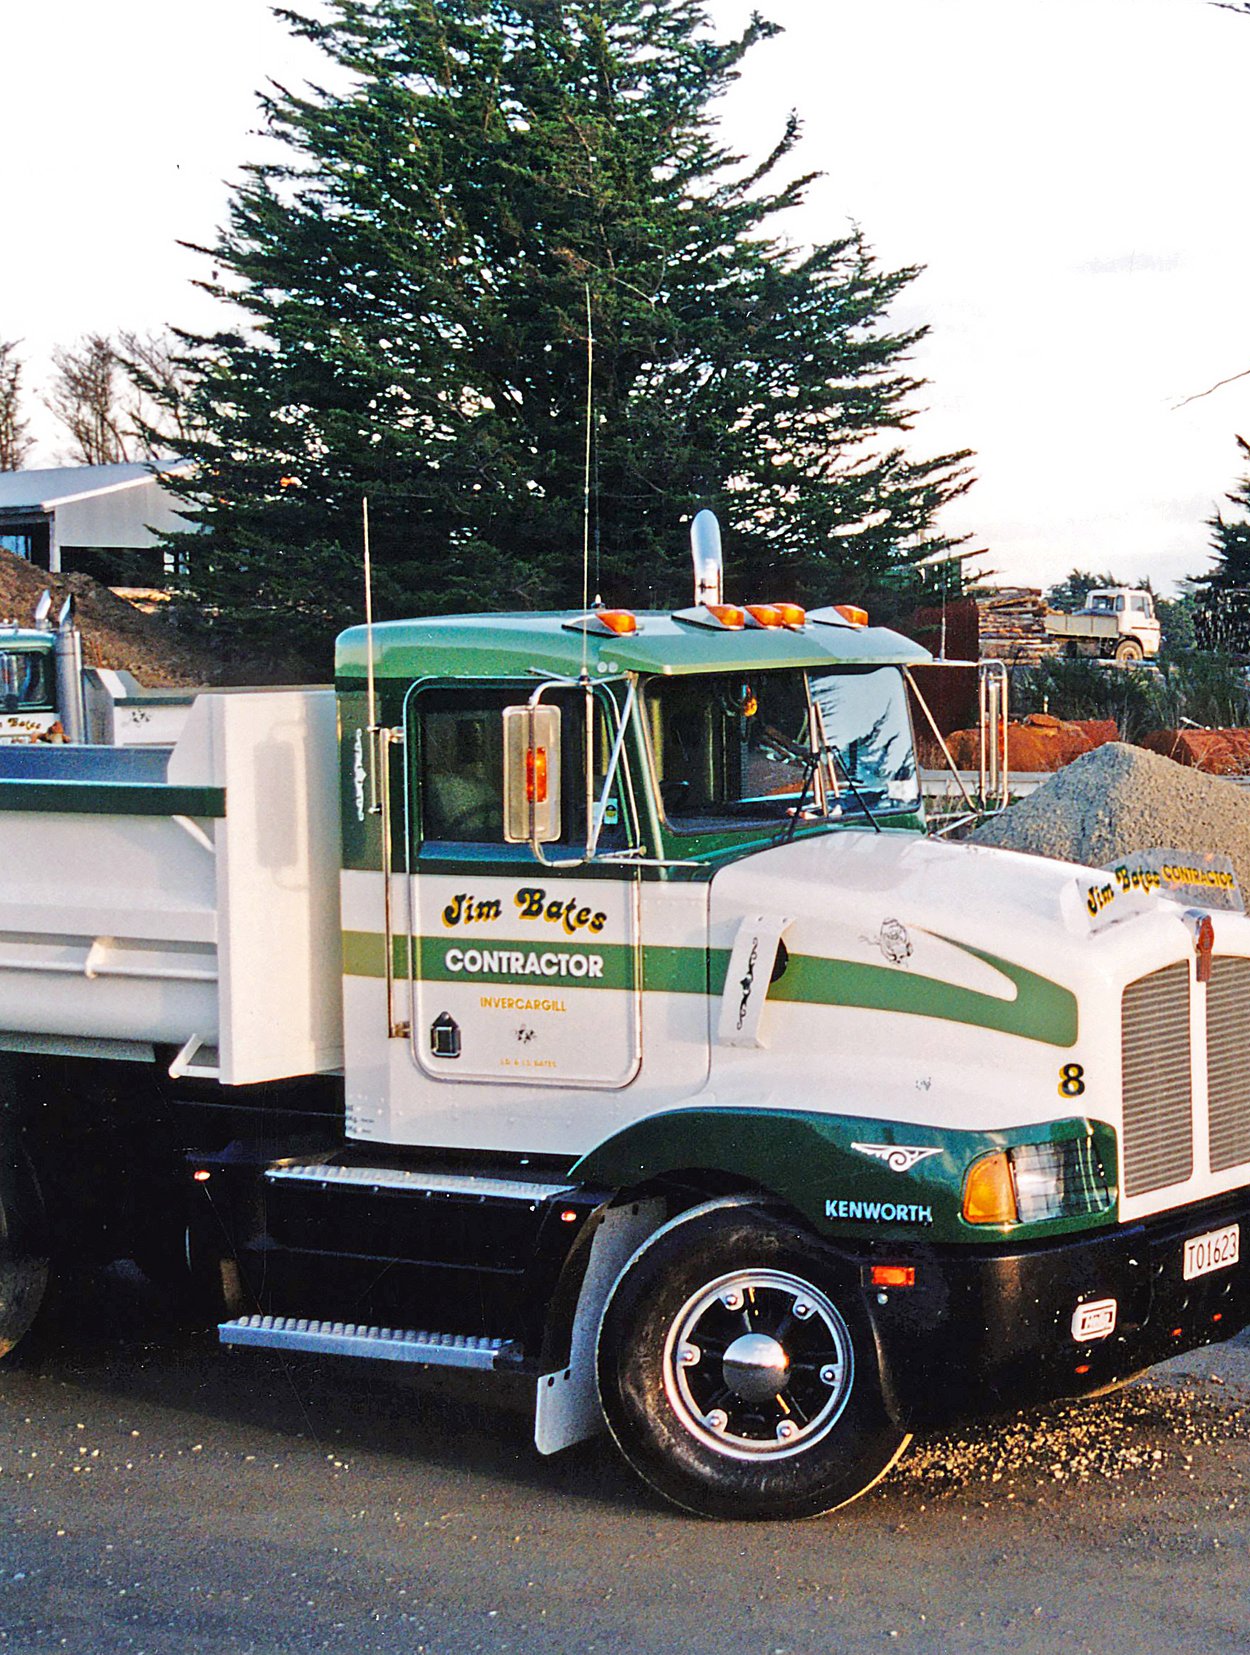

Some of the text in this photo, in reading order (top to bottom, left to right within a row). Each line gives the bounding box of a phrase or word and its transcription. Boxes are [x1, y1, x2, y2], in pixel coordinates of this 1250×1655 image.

[1087, 863, 1236, 918] Jim Bates CONTRACTOR
[441, 887, 608, 935] Jim Bates
[445, 948, 605, 978] CONTRACTOR
[480, 996, 567, 1012] INVERCARGILL
[1057, 1062, 1086, 1099] 8
[825, 1199, 933, 1222] KENWORTH
